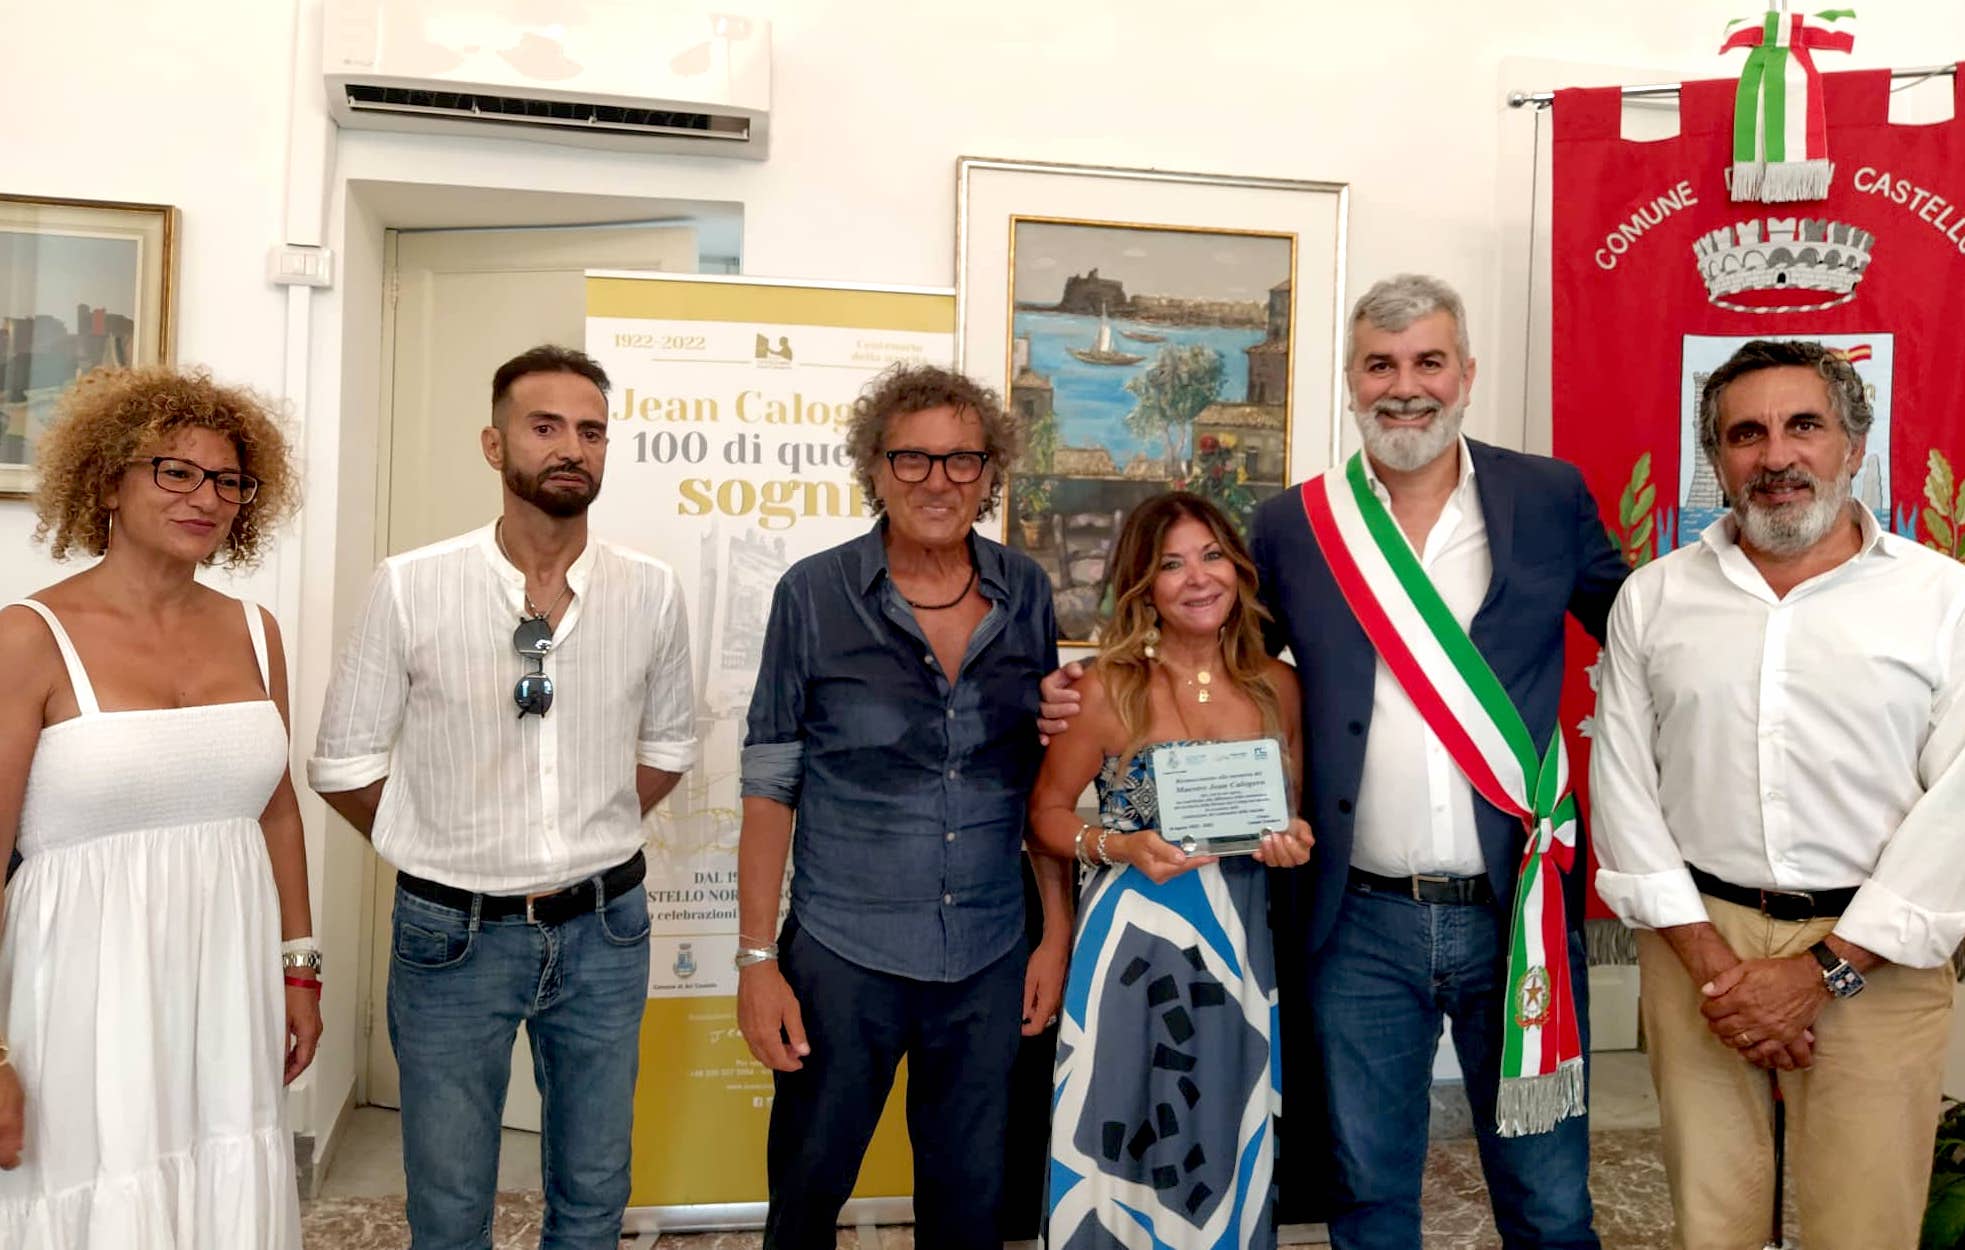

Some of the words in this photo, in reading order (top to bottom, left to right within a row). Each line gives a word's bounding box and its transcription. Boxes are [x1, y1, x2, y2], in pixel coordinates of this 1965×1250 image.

[1595, 180, 1699, 271] COMUNE
[614, 333, 706, 350] 1922-2022
[612, 388, 719, 422] Jean
[735, 390, 857, 433] Calog
[632, 431, 708, 464] 100
[723, 433, 762, 465] di
[777, 441, 855, 474] que
[677, 472, 865, 530] sogni
[694, 871, 723, 884] DAL
[648, 889, 704, 902] STELLO
[709, 889, 738, 902] NOR
[657, 909, 737, 921] celebrazioni
